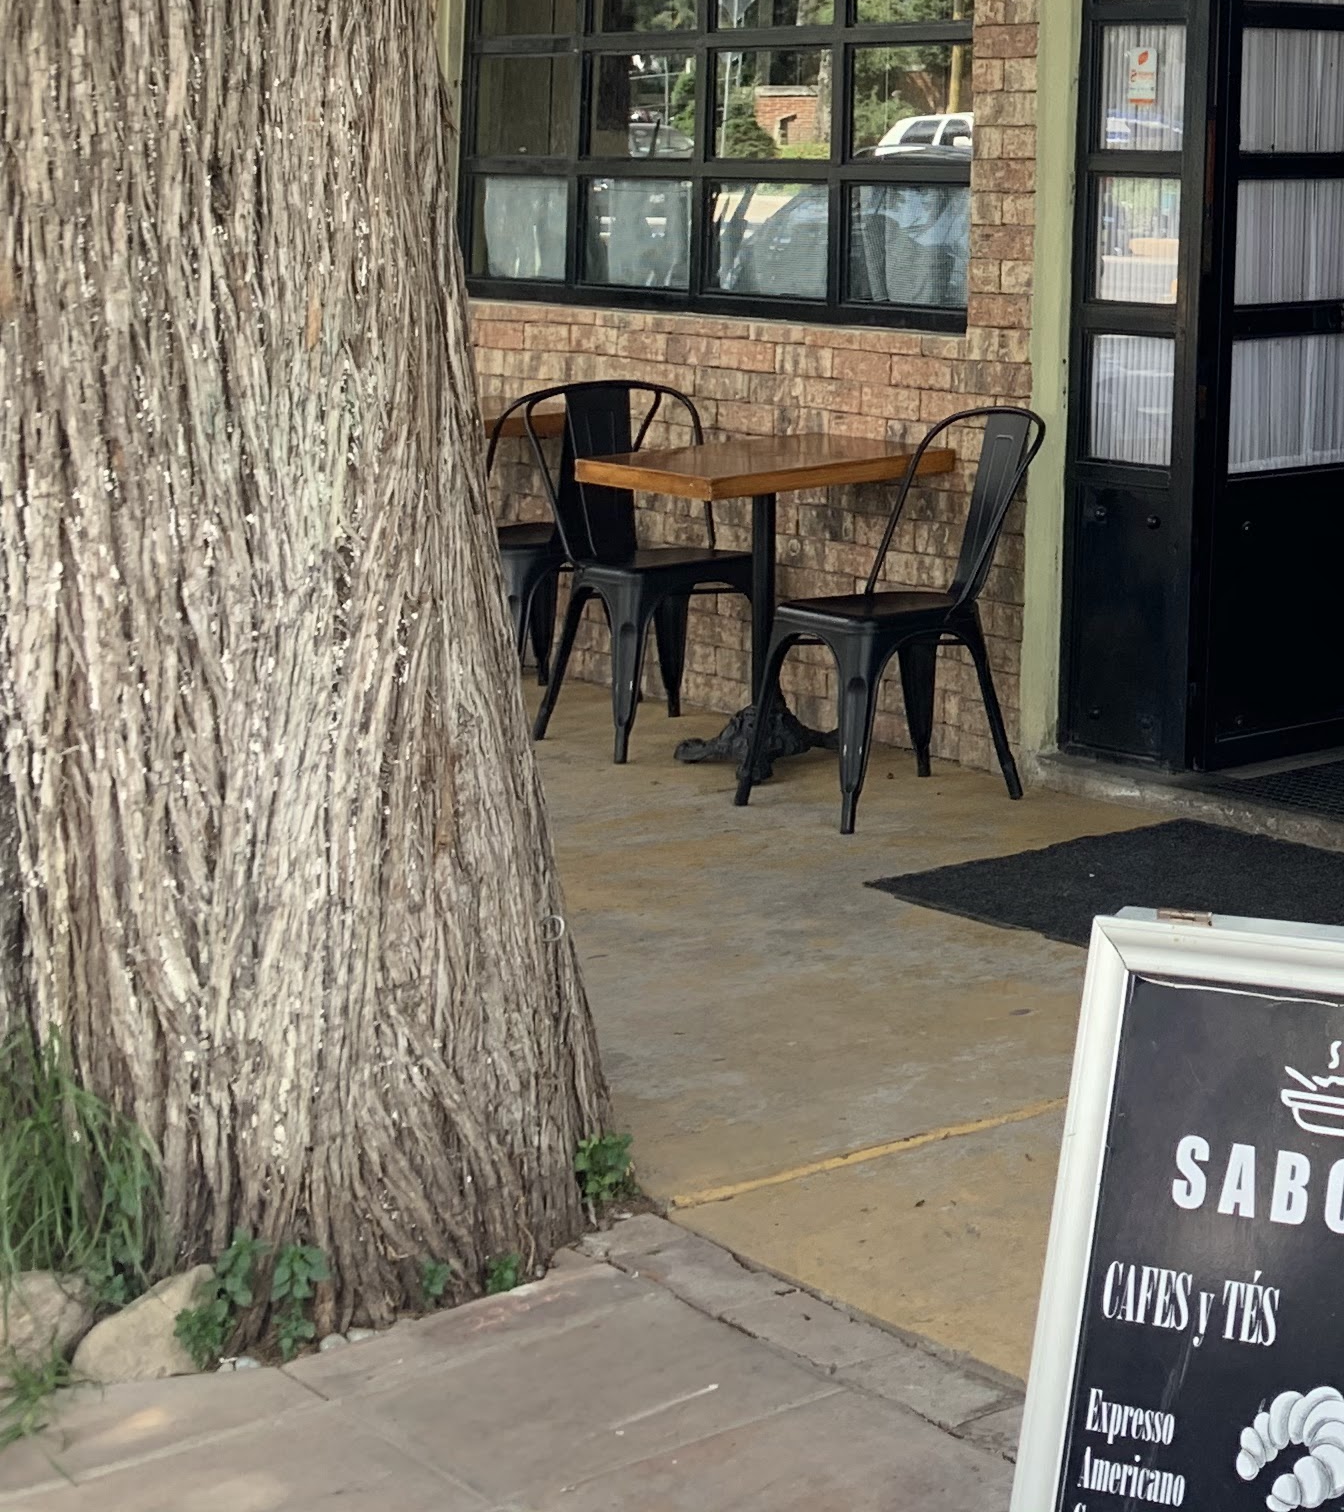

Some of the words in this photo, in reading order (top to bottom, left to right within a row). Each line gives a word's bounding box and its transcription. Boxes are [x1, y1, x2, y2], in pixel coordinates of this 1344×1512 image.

[1102, 1260, 1193, 1332] CAFES
[1192, 1291, 1215, 1347] y
[1221, 1270, 1281, 1347] TÉS
[1085, 1387, 1176, 1446] Expresso
[1076, 1445, 1186, 1508] Americano
